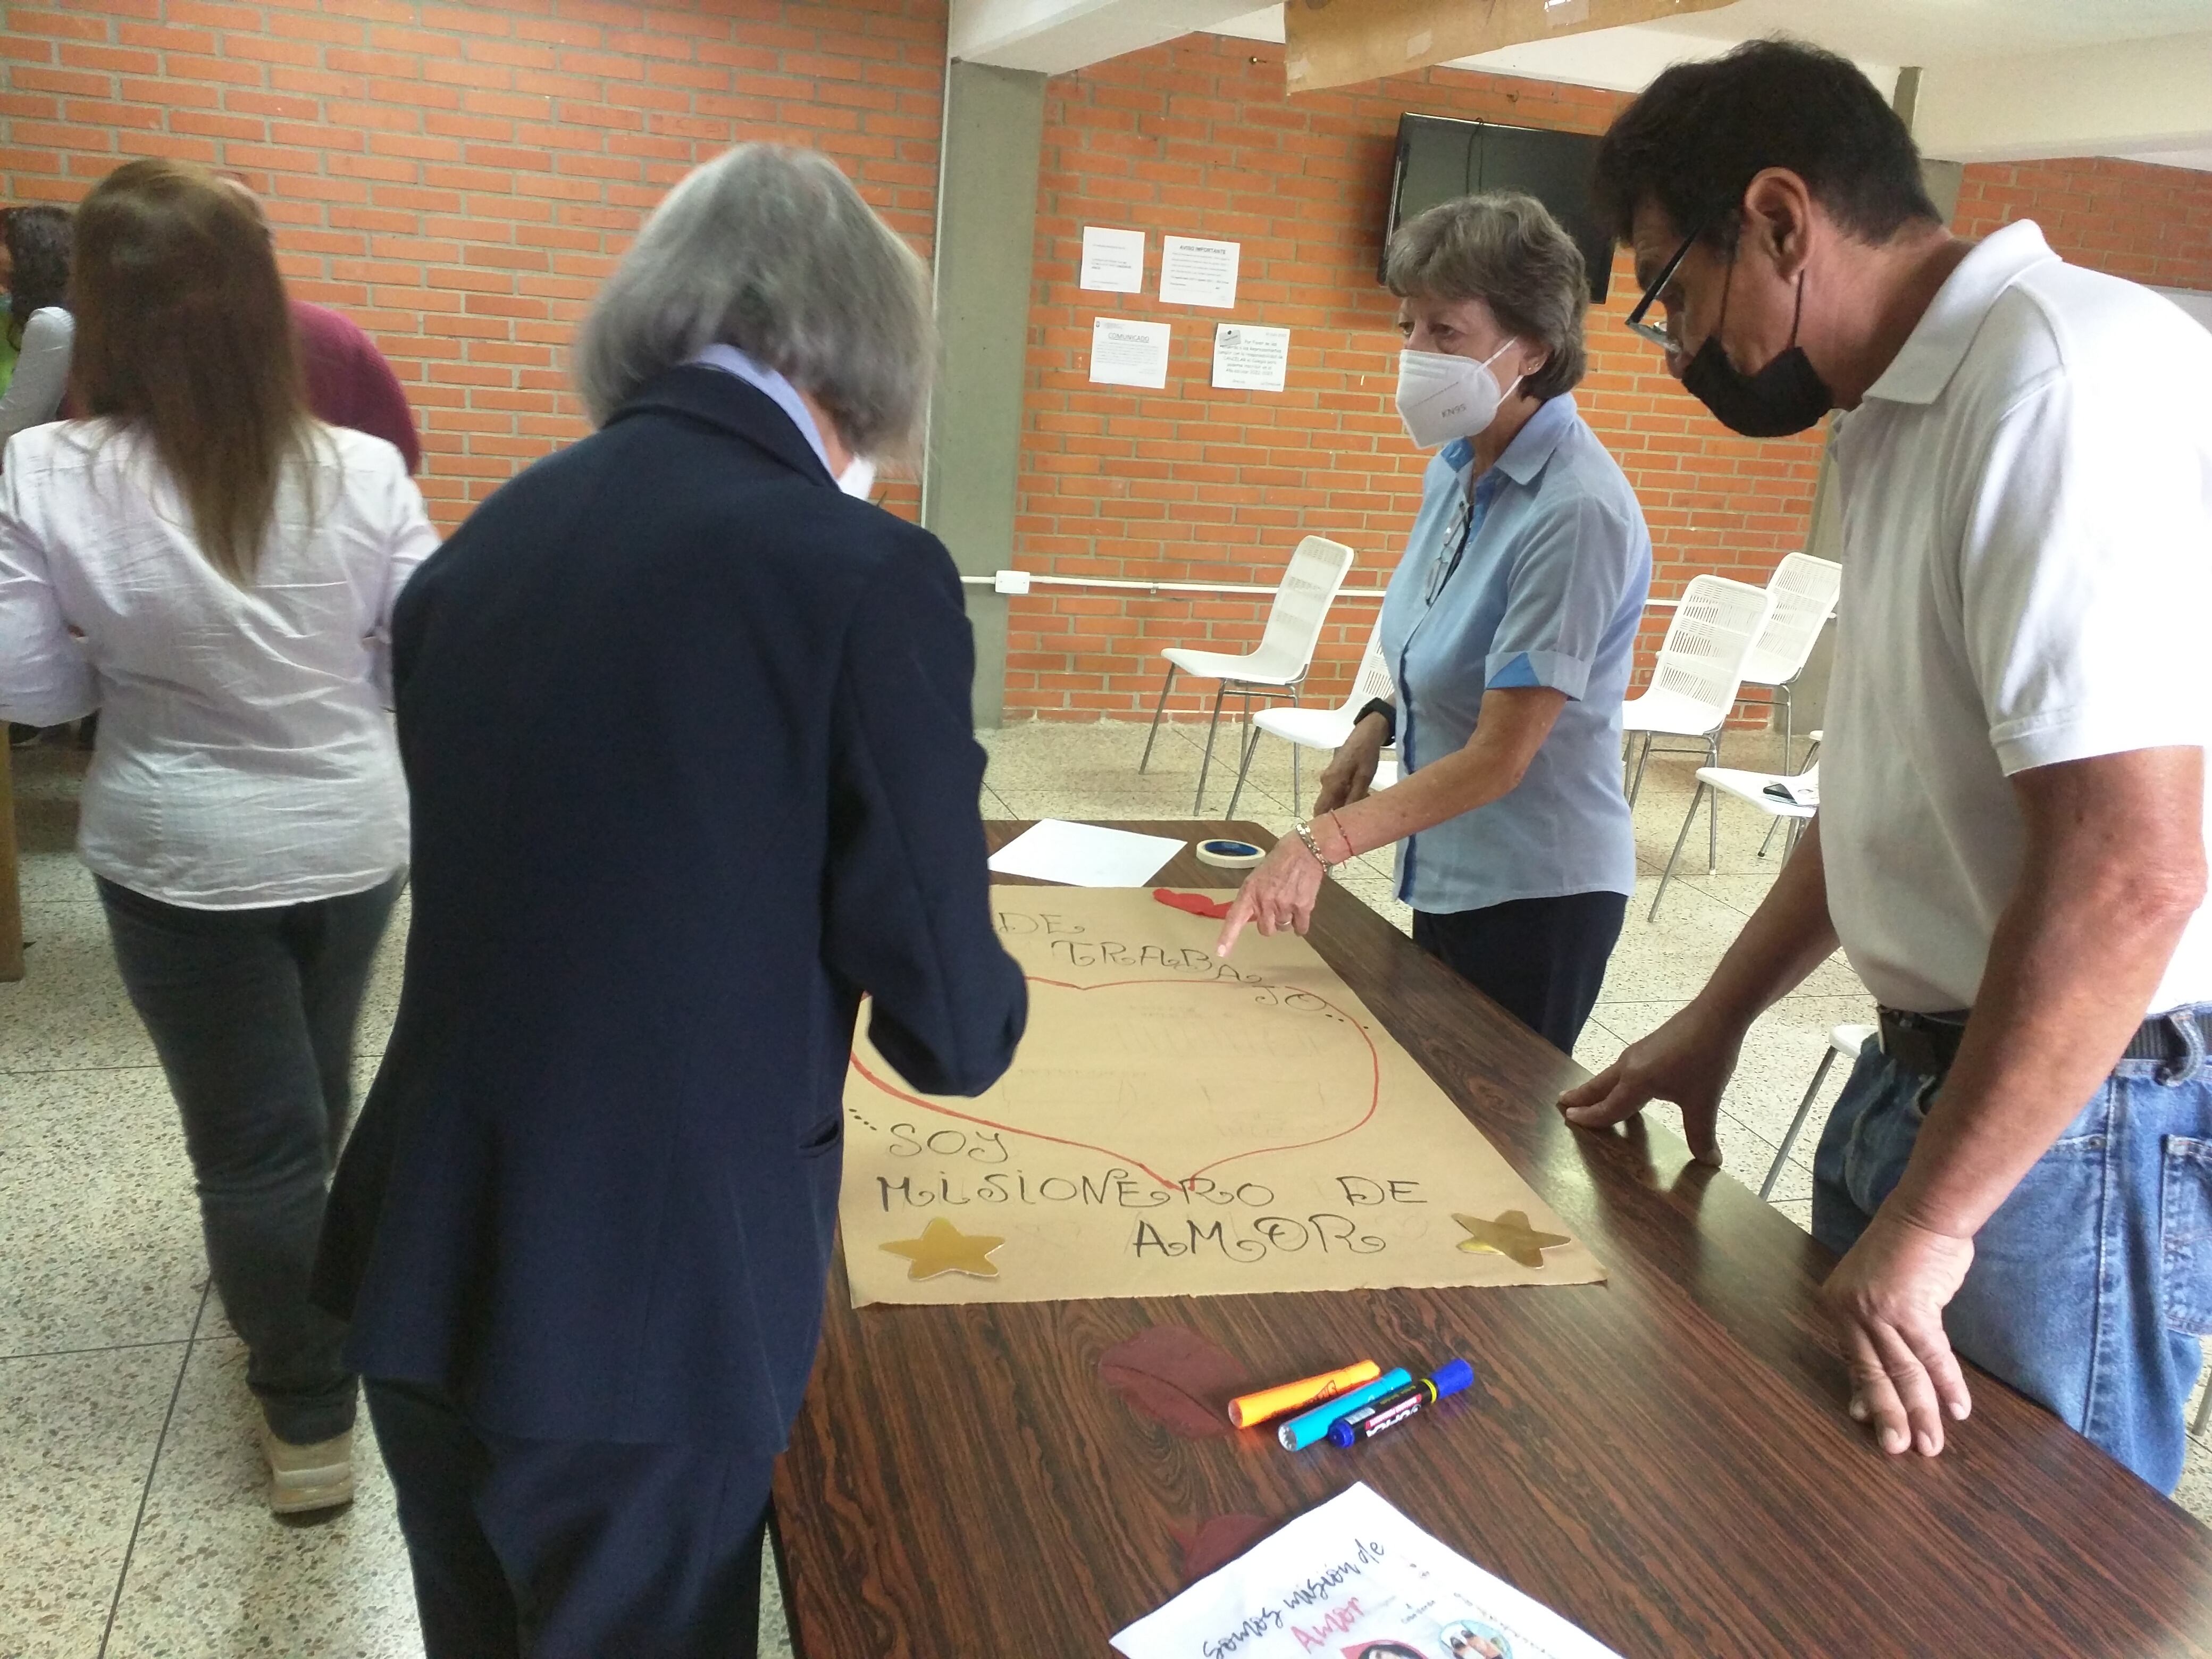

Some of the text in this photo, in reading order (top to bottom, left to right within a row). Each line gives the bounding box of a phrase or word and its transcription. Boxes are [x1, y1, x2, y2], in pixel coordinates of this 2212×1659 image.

[1108, 332, 1149, 342] COMUNICADO
[1441, 403, 1467, 418] KN95
[999, 912, 1085, 934] DE
[1336, 1175, 1428, 1206] DE
[1133, 1213, 1386, 1262] AMOR
[1355, 1538, 1385, 1564] de
[1290, 1597, 1364, 1654] Amor
